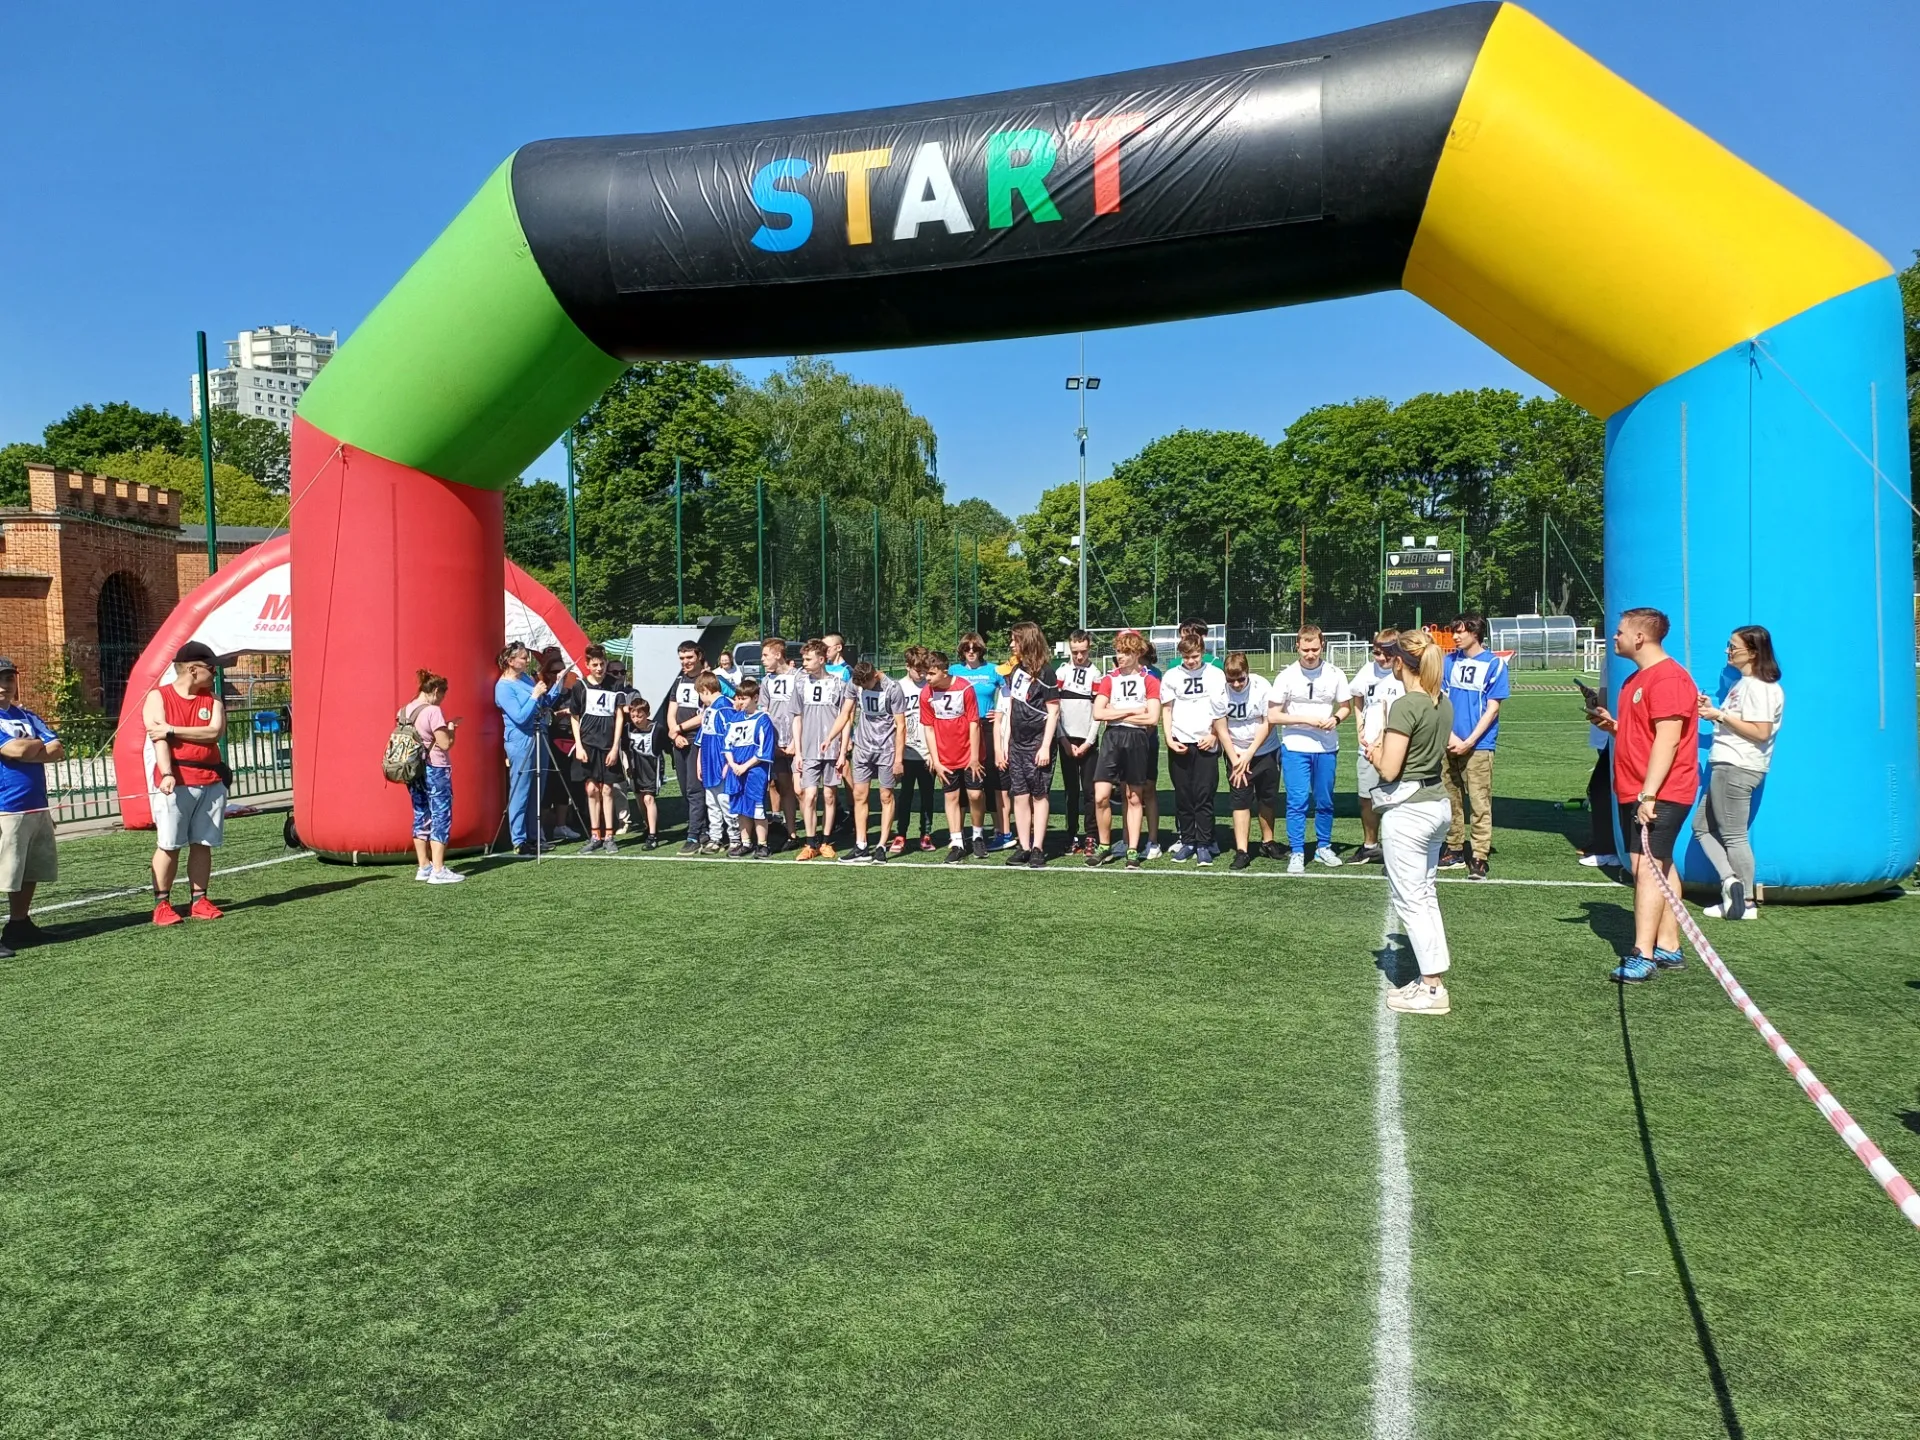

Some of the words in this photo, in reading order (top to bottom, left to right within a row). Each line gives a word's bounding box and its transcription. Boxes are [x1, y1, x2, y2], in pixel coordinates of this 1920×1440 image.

[750, 112, 1146, 253] START
[1072, 668, 1087, 685] 19
[1460, 665, 1477, 684] 13
[773, 679, 787, 695] 21
[812, 686, 822, 702] 9
[1120, 680, 1137, 697] 12
[1183, 677, 1204, 695] 25
[1306, 682, 1314, 700] 1
[596, 692, 606, 708] 4
[682, 688, 690, 703] 3
[865, 695, 879, 712] 10
[943, 694, 953, 711] 2
[1227, 702, 1247, 719] 20
